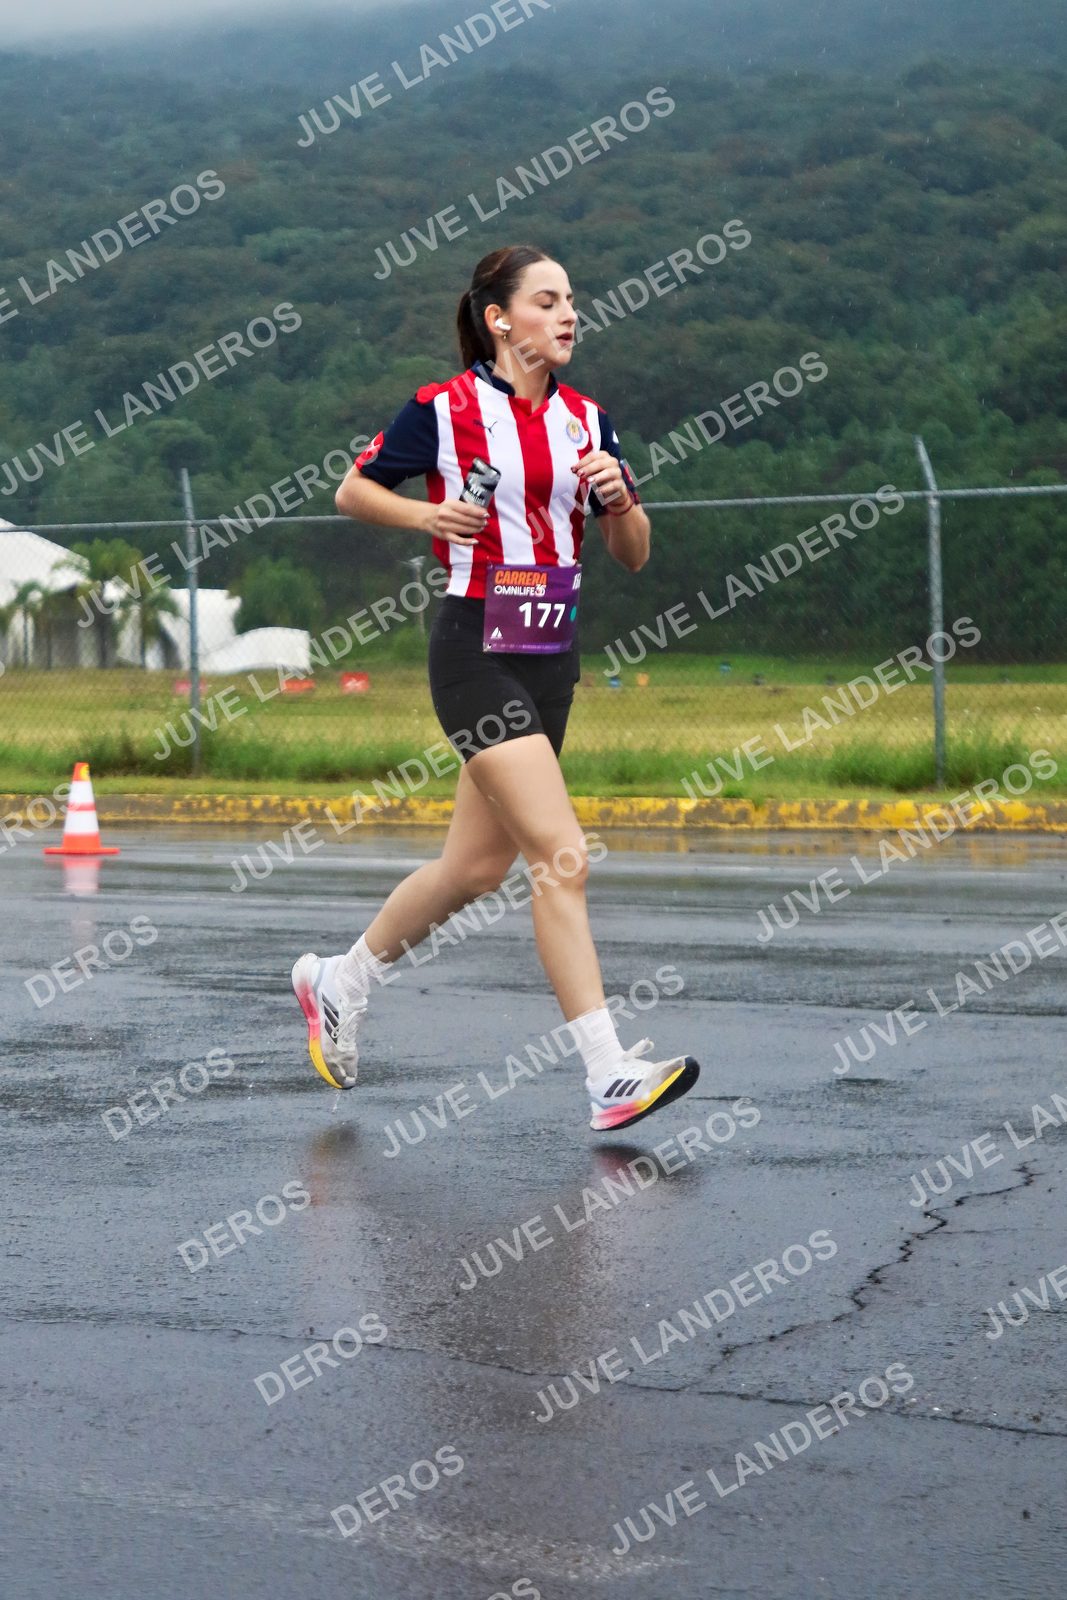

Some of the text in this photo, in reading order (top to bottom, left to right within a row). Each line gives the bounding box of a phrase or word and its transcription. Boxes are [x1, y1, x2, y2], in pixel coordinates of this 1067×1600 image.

[495, 570, 547, 587] CARRERA
[494, 585, 535, 597] OMNILIFE
[519, 602, 566, 628] 177
